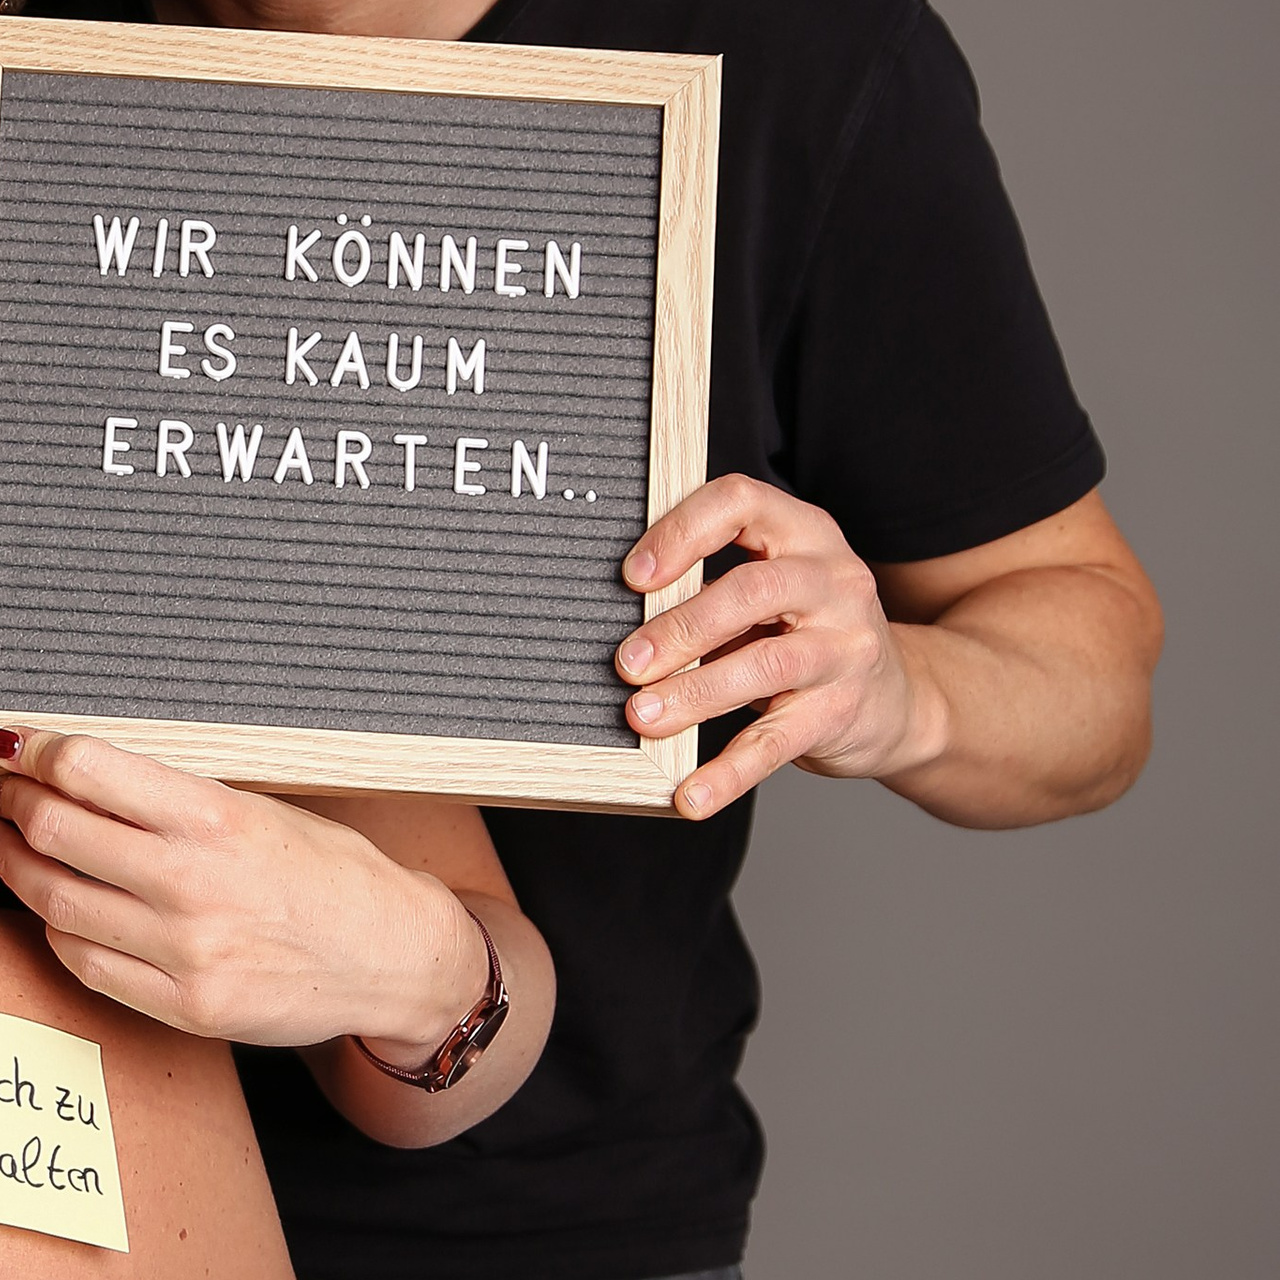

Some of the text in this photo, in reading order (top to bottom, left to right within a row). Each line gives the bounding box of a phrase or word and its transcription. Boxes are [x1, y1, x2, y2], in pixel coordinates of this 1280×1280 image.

[92, 211, 584, 301] WIR KÖNNEN
[157, 318, 488, 398] ES KAUM
[101, 414, 599, 505] ERWARTEN..
[55, 1086, 100, 1131] zu
